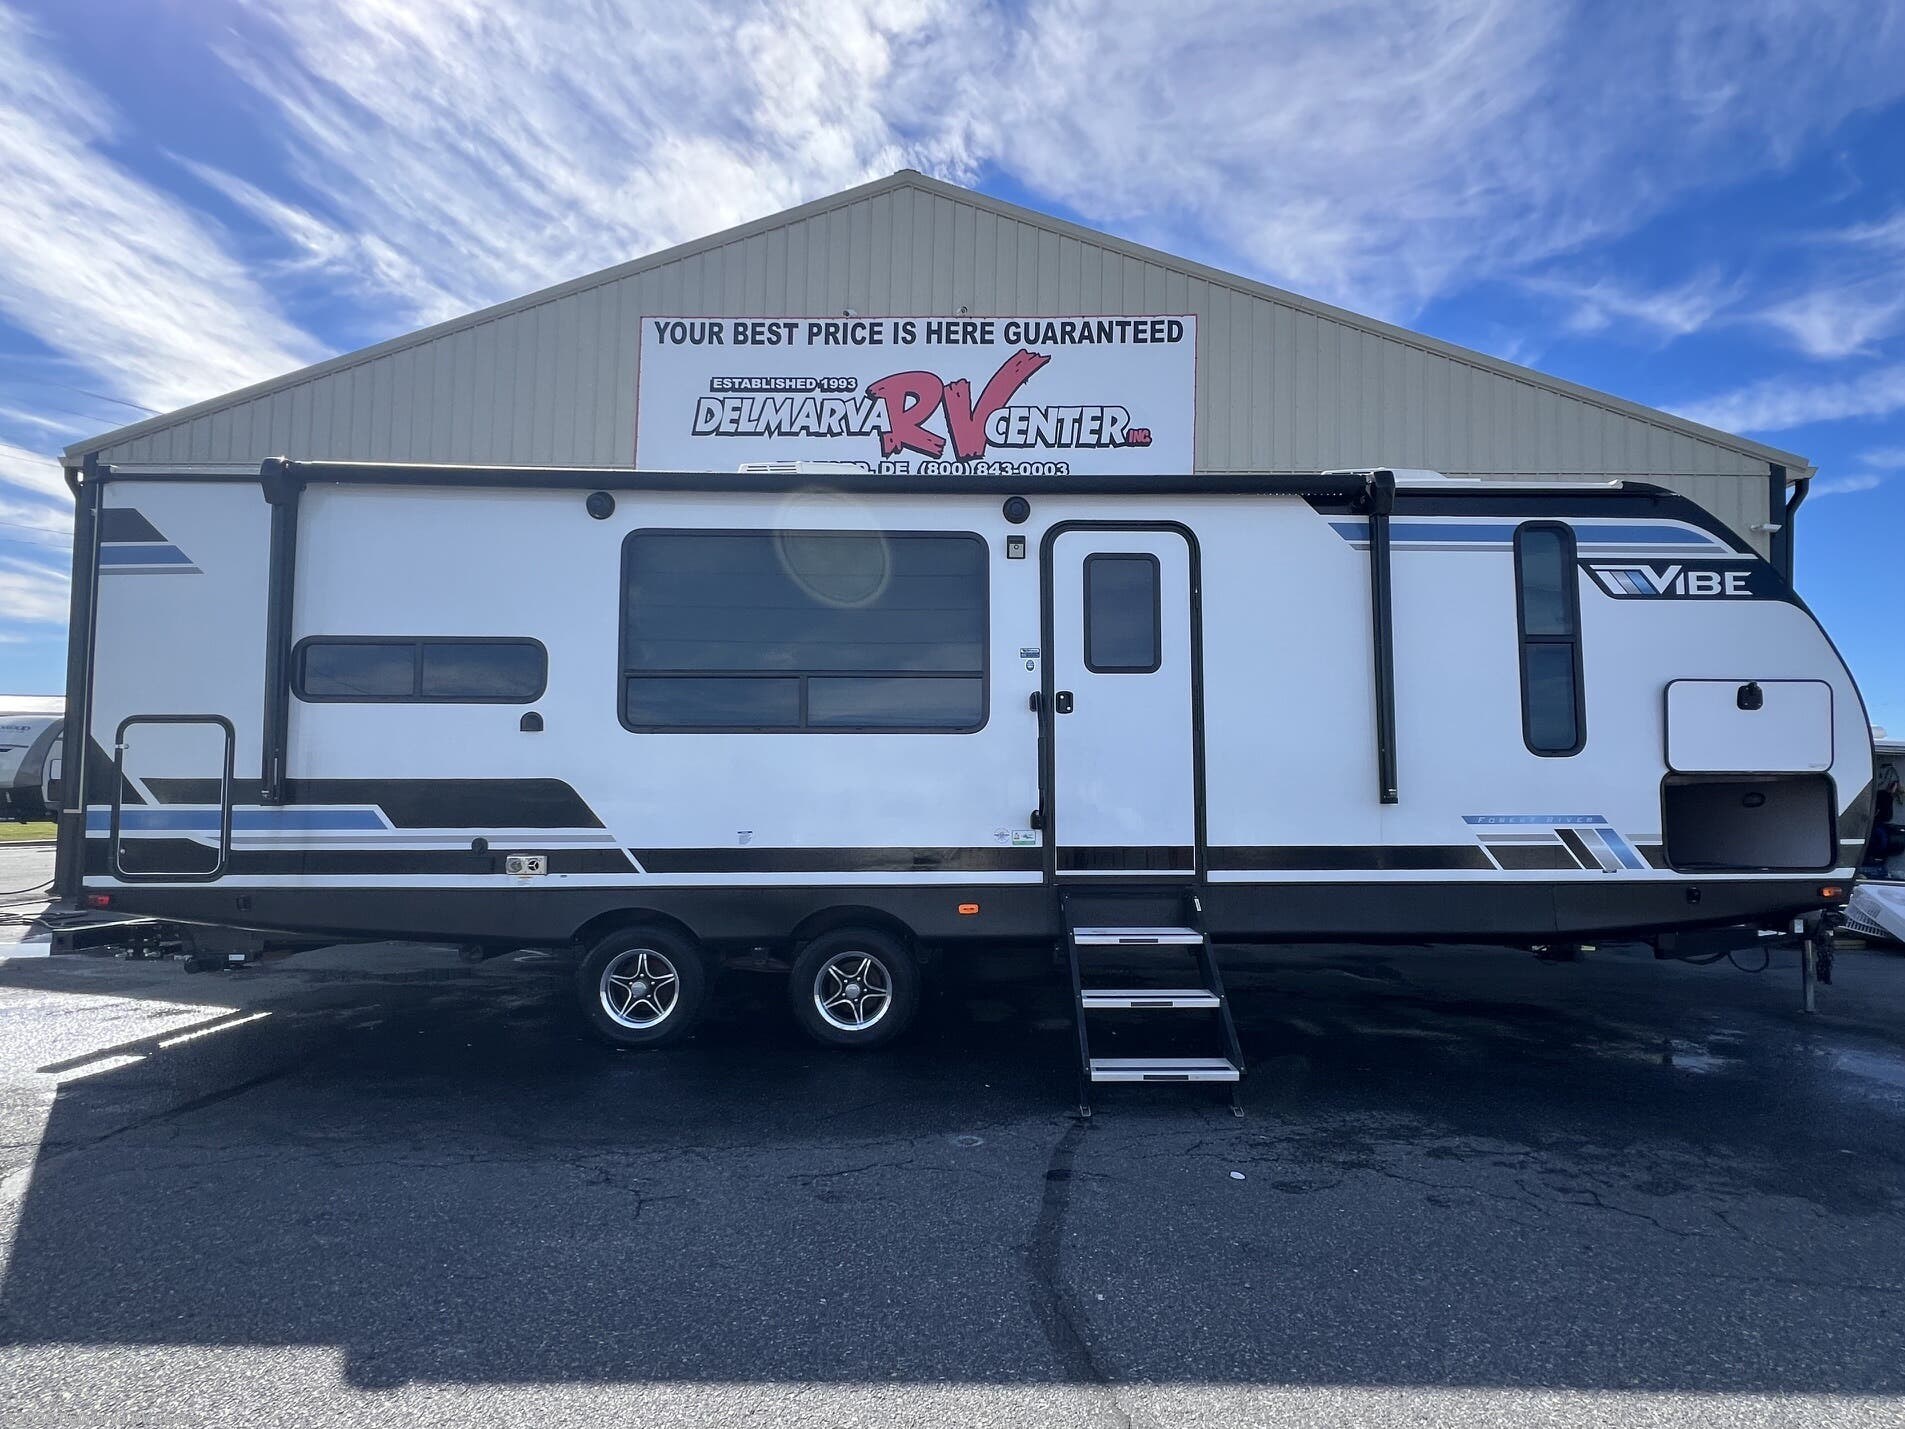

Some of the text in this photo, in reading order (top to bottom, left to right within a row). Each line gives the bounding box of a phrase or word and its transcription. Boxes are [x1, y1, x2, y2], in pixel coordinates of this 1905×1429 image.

[655, 319, 1184, 345] YOUR BEST PRICE IS HERE GUARANTEED
[711, 377, 858, 392] ESTABLISHED 1993
[692, 397, 893, 438] DELMARVA
[865, 348, 1051, 462] RV
[985, 405, 1131, 448] CENTER
[881, 461, 910, 475] DE
[918, 461, 973, 475] (800)
[976, 461, 1070, 475] 843-0003
[1640, 565, 1753, 595] VIBE
